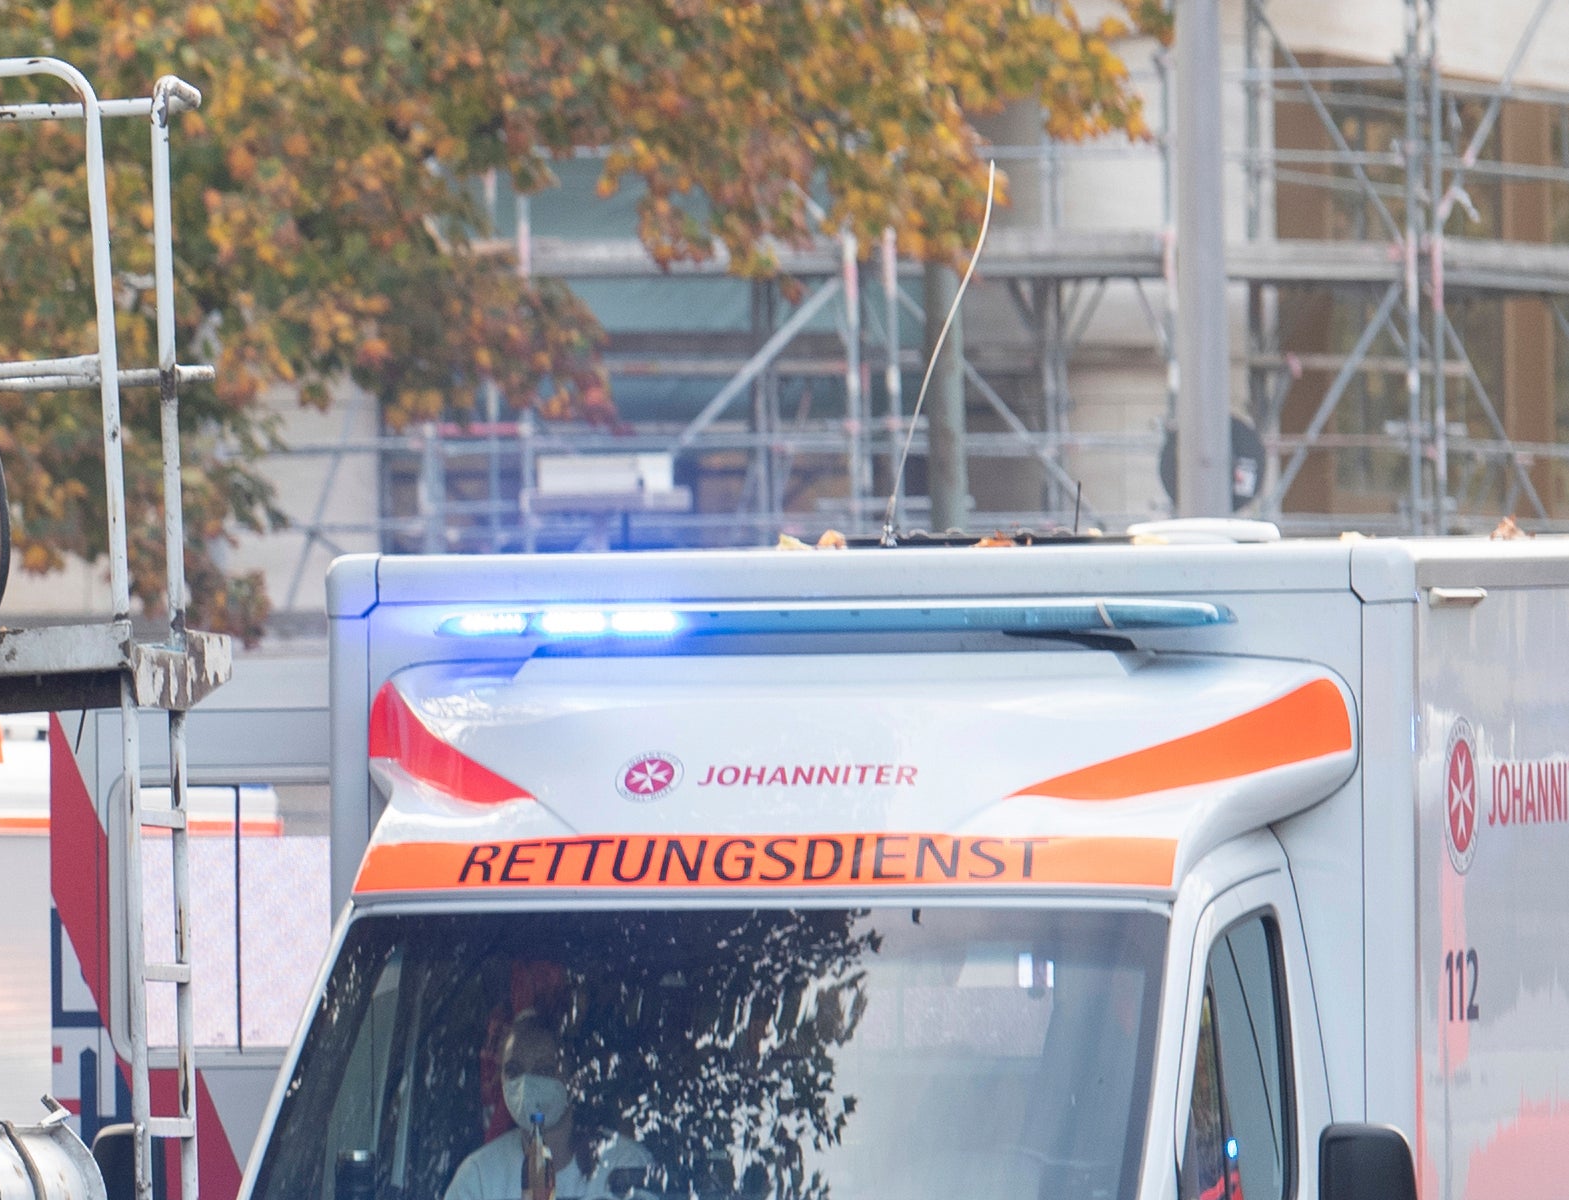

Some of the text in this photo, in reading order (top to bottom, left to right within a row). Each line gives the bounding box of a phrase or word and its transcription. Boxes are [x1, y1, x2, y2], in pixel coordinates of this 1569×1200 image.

[696, 763, 919, 788] JOHANNITER
[1487, 760, 1569, 827] JOHANNI
[457, 835, 1049, 885] RETTUNGSDIENST
[1445, 946, 1480, 1022] 112
